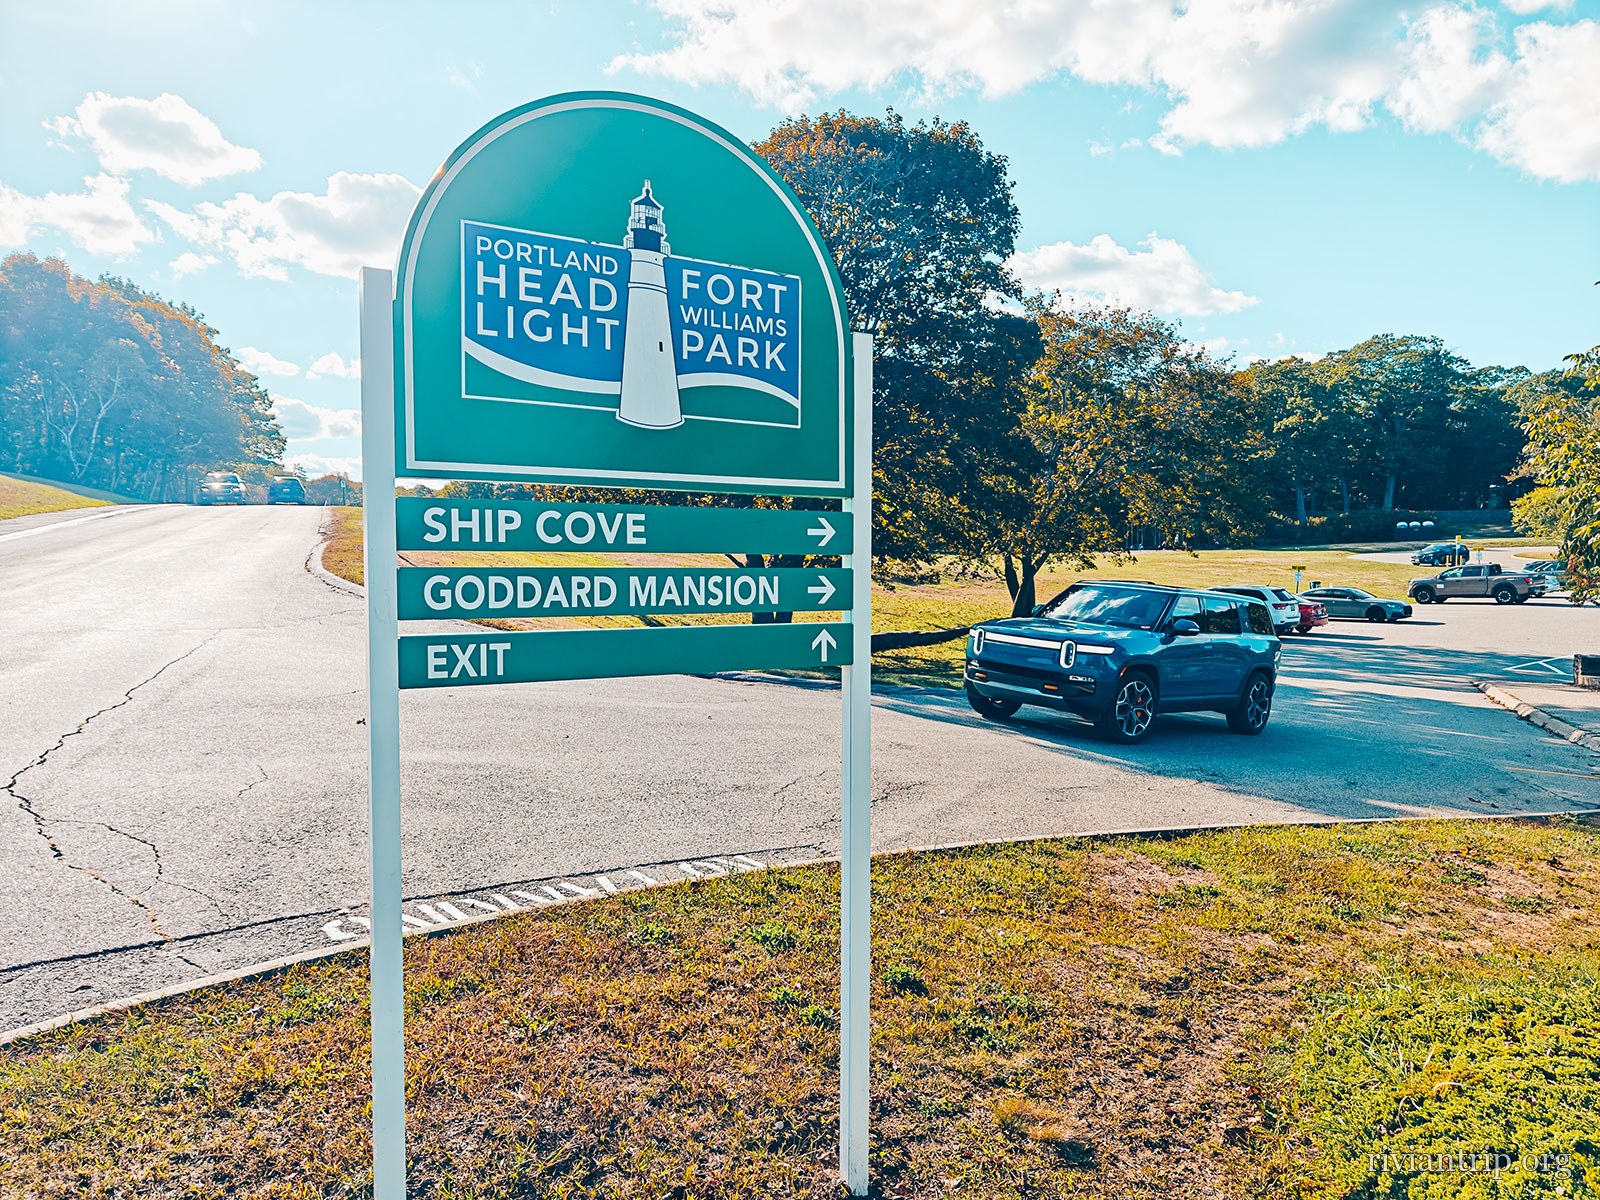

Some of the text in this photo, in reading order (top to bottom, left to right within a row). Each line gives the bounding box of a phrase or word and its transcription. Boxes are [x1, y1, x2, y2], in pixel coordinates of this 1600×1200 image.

[476, 235, 618, 275] PORTLAND
[476, 261, 618, 311] HEAD
[682, 269, 787, 313] FORT
[476, 302, 620, 350] LIGHT
[680, 305, 787, 336] WILLIAMS
[682, 330, 786, 371] PARK
[423, 507, 647, 545] SHIP COVE
[424, 575, 779, 610] GODDARD MANSION
[427, 643, 511, 679] EXIT
